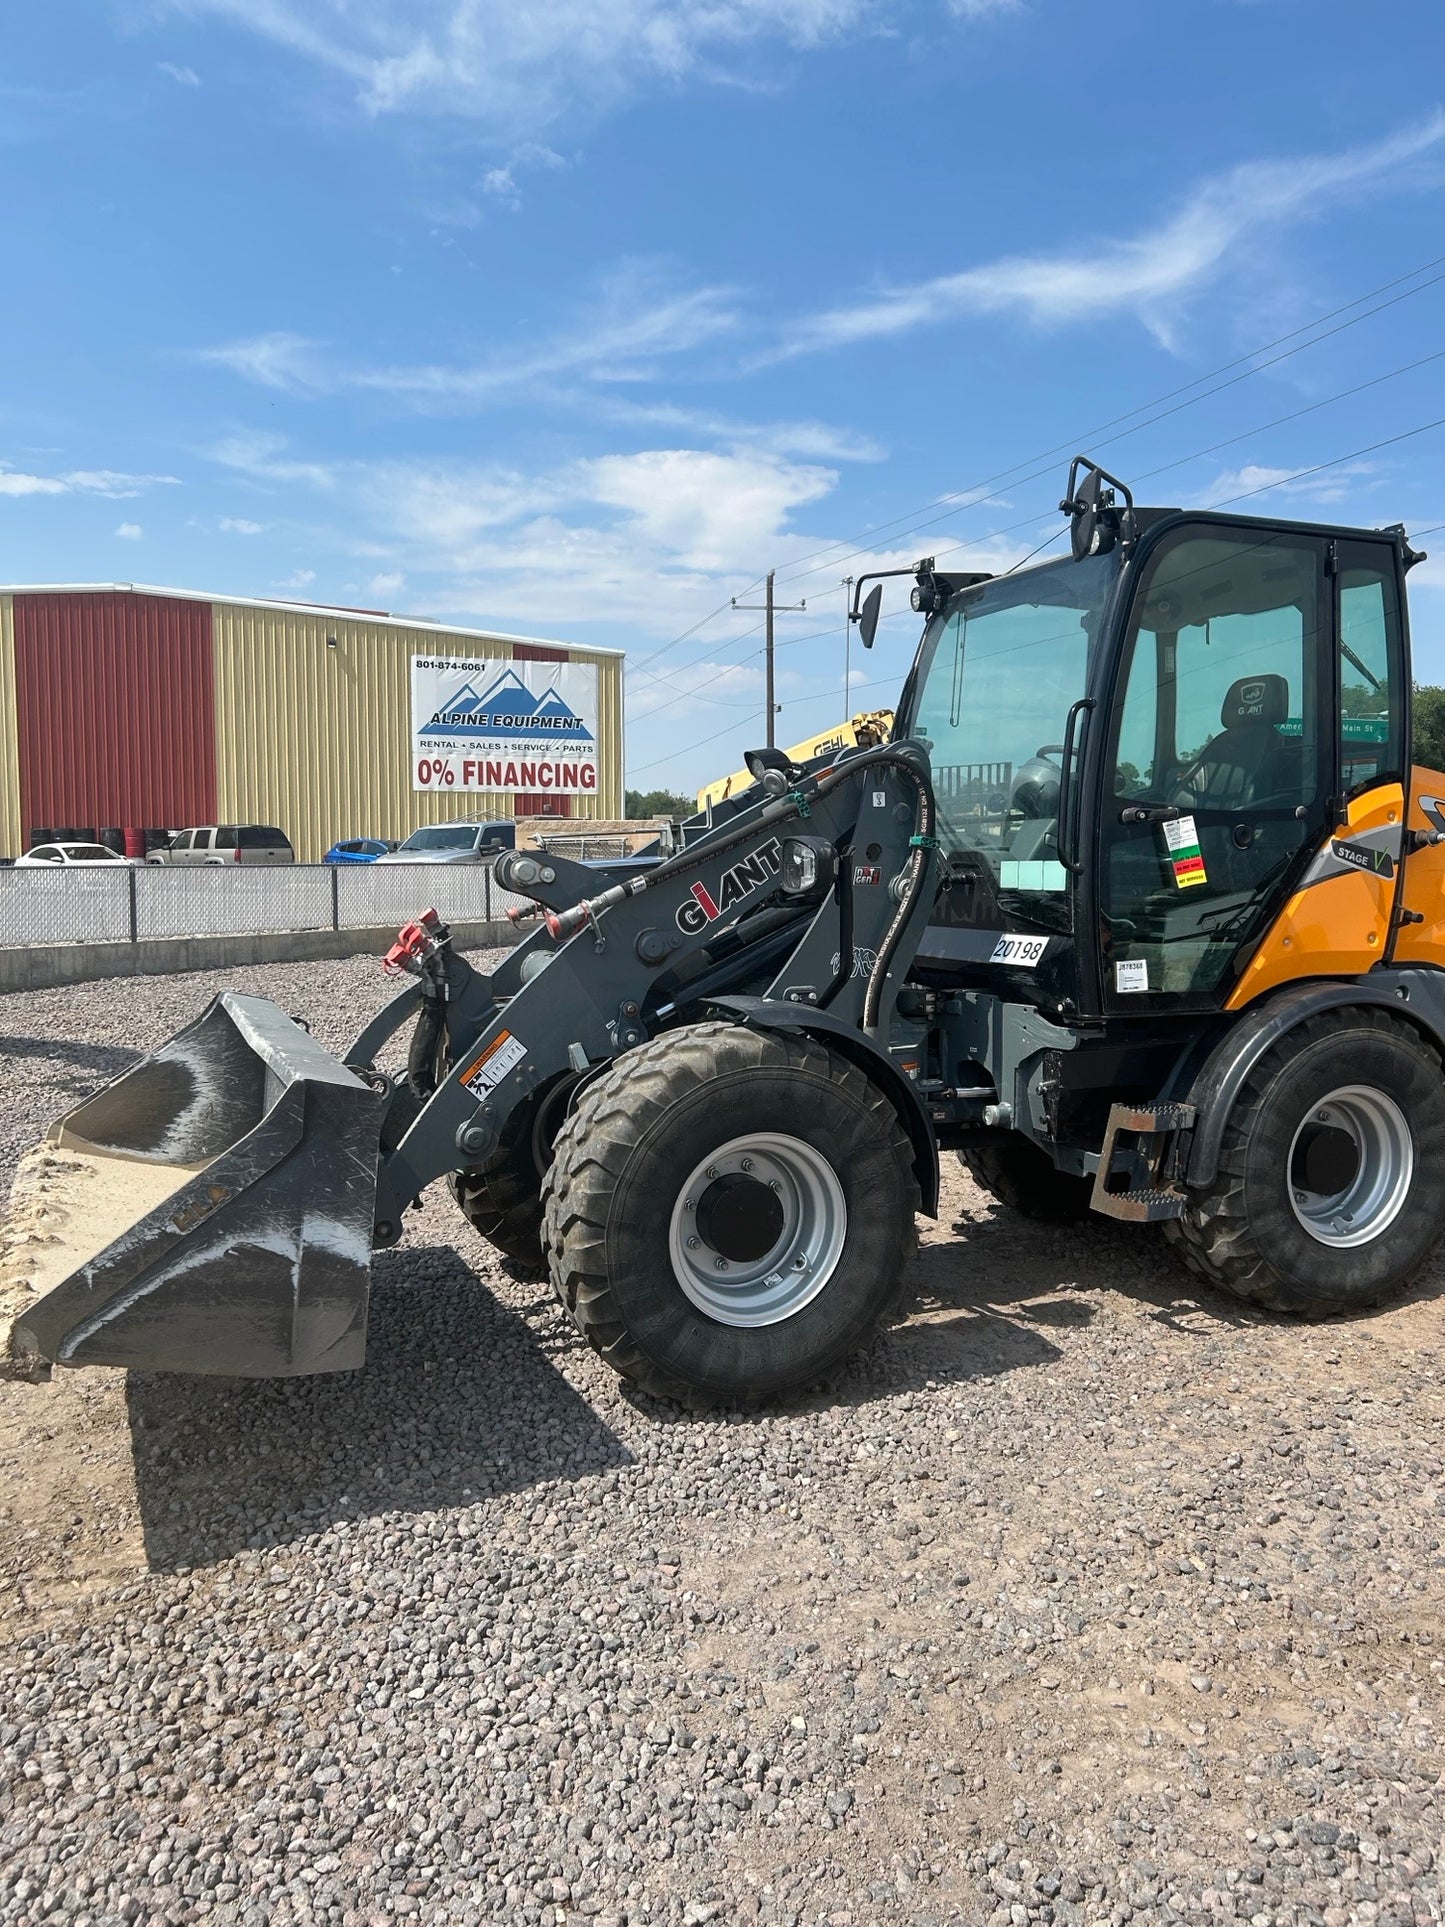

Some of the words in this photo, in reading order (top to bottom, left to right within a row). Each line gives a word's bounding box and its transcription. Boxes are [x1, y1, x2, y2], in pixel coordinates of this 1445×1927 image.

[416, 660, 486, 672] 801-874-6061
[430, 712, 488, 726] ALPINE
[492, 714, 584, 729] EQUIPMENT
[1342, 724, 1361, 732] Main
[1364, 724, 1374, 733] St
[419, 740, 459, 749] RENTAL
[469, 741, 501, 750] SALES
[511, 743, 552, 752] SERVICE
[562, 744, 594, 753] PARTS
[813, 734, 850, 757] GEHL
[417, 759, 455, 786] 0%
[462, 760, 596, 788] FINANCING
[1338, 847, 1369, 866] STAGE
[1374, 842, 1392, 871] V
[993, 939, 1043, 960] 20198
[475, 1043, 498, 1070] WARNING
[172, 1185, 231, 1233] HLA
